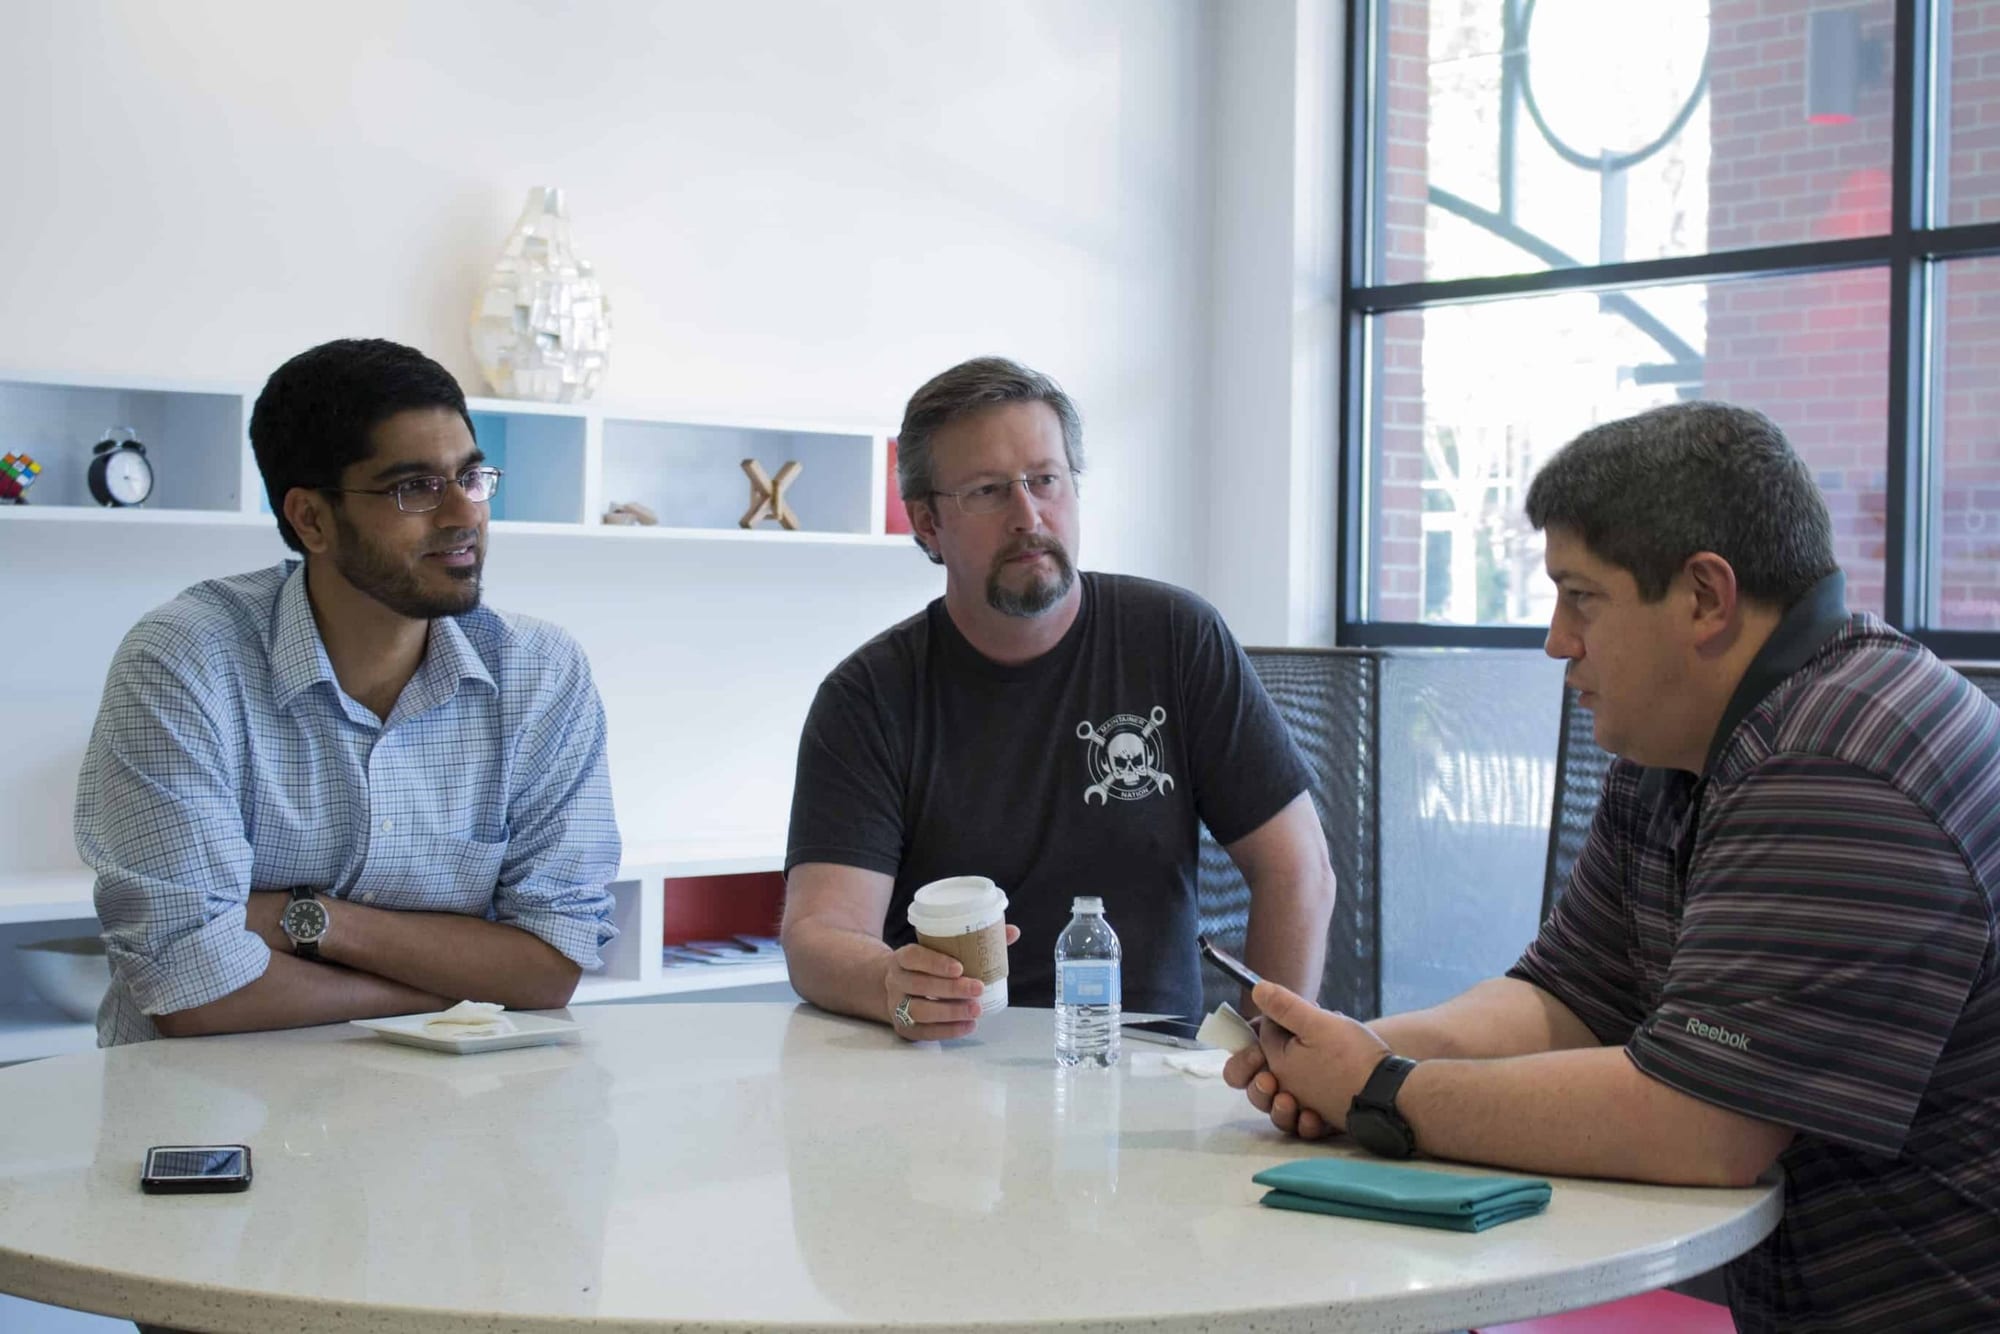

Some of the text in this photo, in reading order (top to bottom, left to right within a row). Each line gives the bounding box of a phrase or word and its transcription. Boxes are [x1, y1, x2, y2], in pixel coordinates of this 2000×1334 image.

[1100, 716, 1146, 733] MAINTAINER
[1121, 788, 1149, 798] NATION
[1686, 1017, 1752, 1051] Reebok
